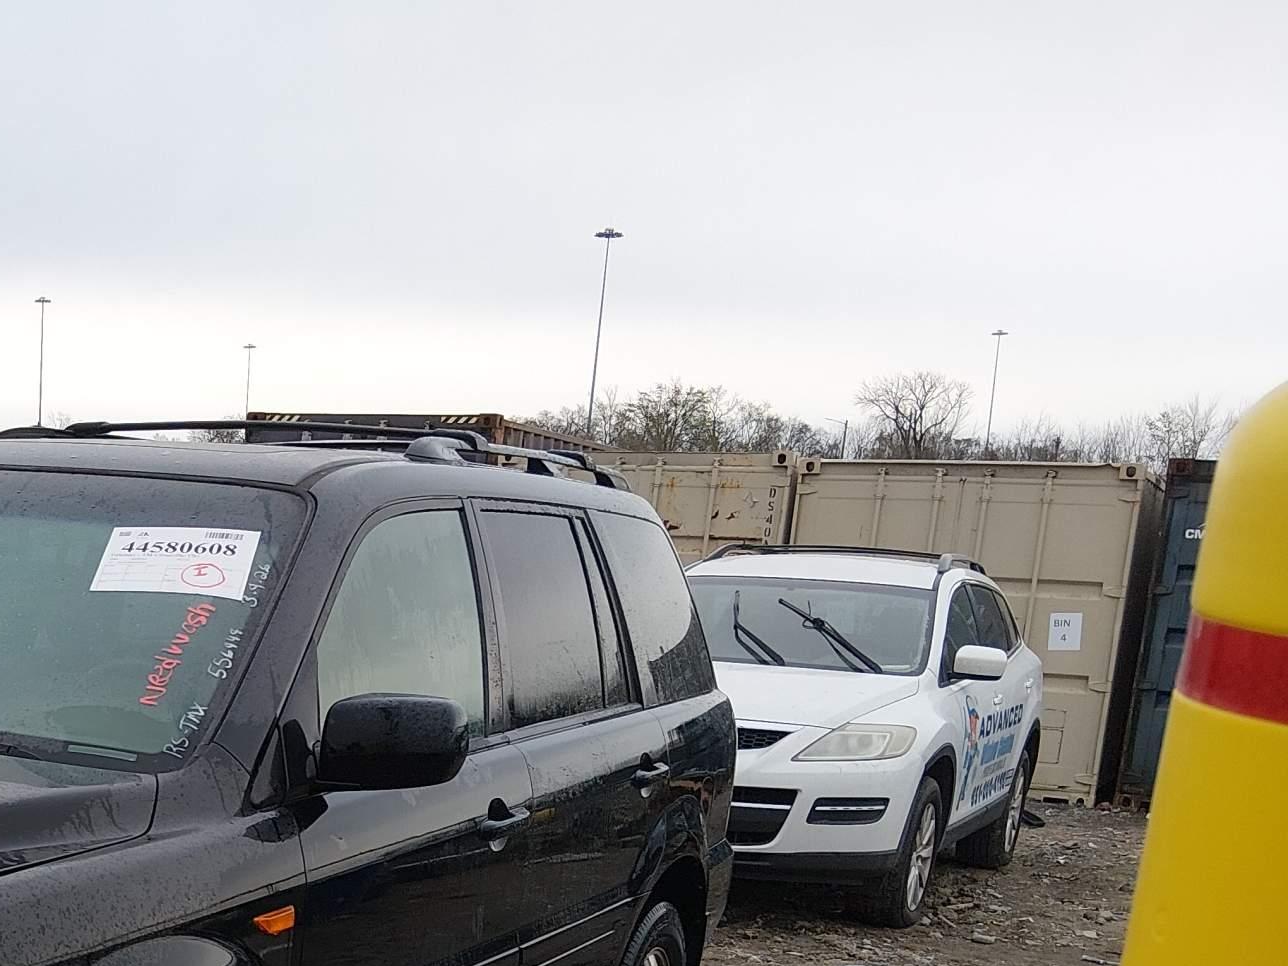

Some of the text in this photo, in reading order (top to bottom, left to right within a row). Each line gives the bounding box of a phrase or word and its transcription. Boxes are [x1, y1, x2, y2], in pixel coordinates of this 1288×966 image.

[120, 541, 238, 556] 44580608
[1053, 619, 1071, 628] BIN
[1059, 633, 1067, 643] 4
[979, 704, 1024, 739] ADVANCED
